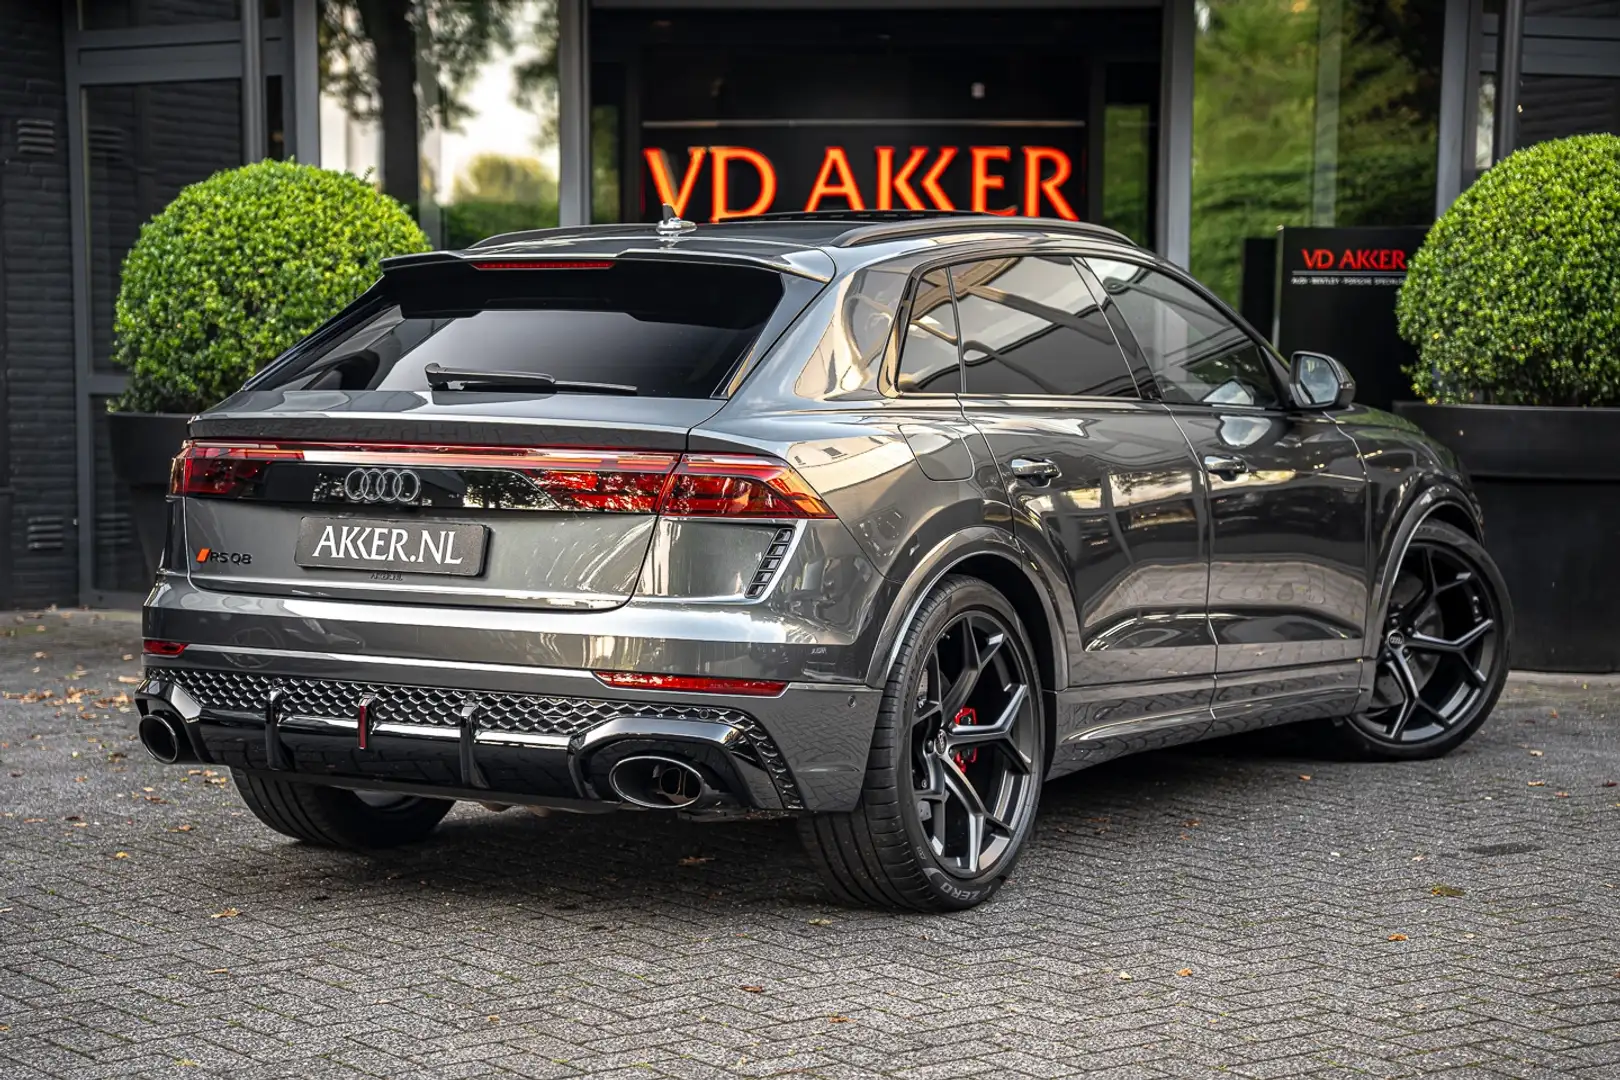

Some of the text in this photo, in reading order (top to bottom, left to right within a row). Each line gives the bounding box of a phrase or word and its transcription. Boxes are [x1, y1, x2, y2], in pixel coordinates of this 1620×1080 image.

[643, 146, 1079, 223] VD AKKER
[1301, 248, 1407, 270] VD AKKER
[312, 525, 463, 565] AKKER.NL
[210, 551, 252, 566] RS Q8
[940, 881, 981, 900] ZERO
